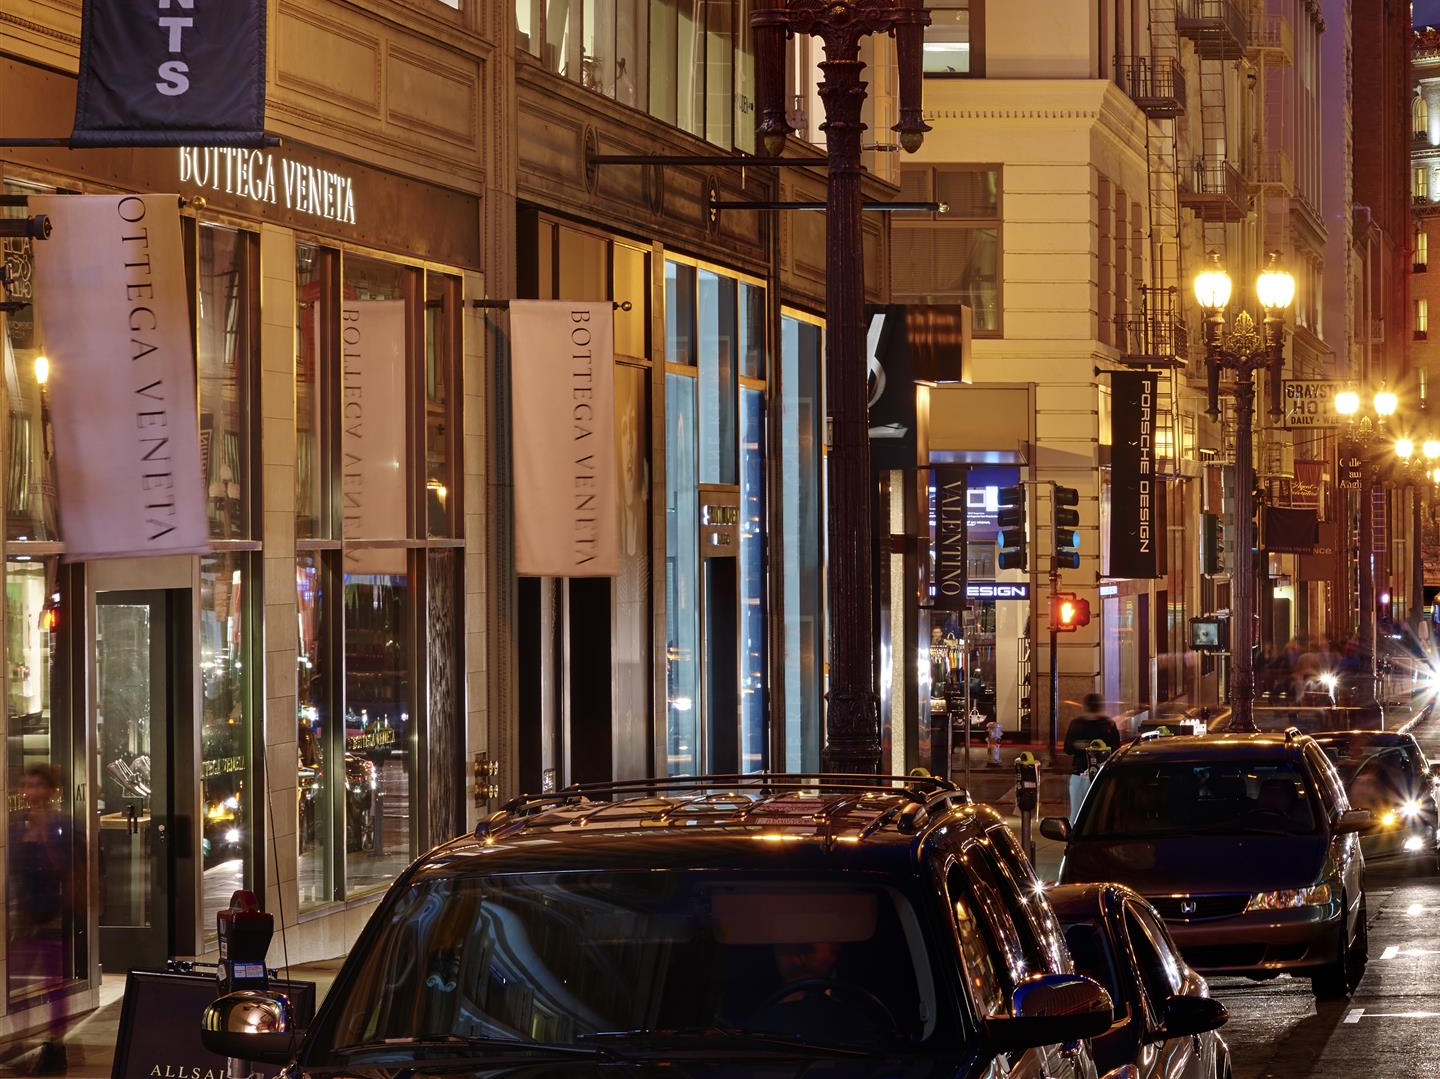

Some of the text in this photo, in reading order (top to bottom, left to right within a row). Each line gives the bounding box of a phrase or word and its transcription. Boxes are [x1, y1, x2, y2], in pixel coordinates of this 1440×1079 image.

[179, 146, 356, 225] BOTTEGA VENETA
[117, 196, 177, 542] OTTEGA VENETA
[1287, 384, 1337, 398] GRAYST
[1291, 416, 1314, 424] DAILY
[1293, 400, 1328, 415] HOT
[571, 310, 599, 566] BOTTEGA VENETA
[1140, 380, 1151, 552] PORSCHE DESIGN
[941, 481, 961, 596] VALENTINO
[967, 586, 1026, 597] ESIGN
[150, 1064, 225, 1079] ALLSAI
